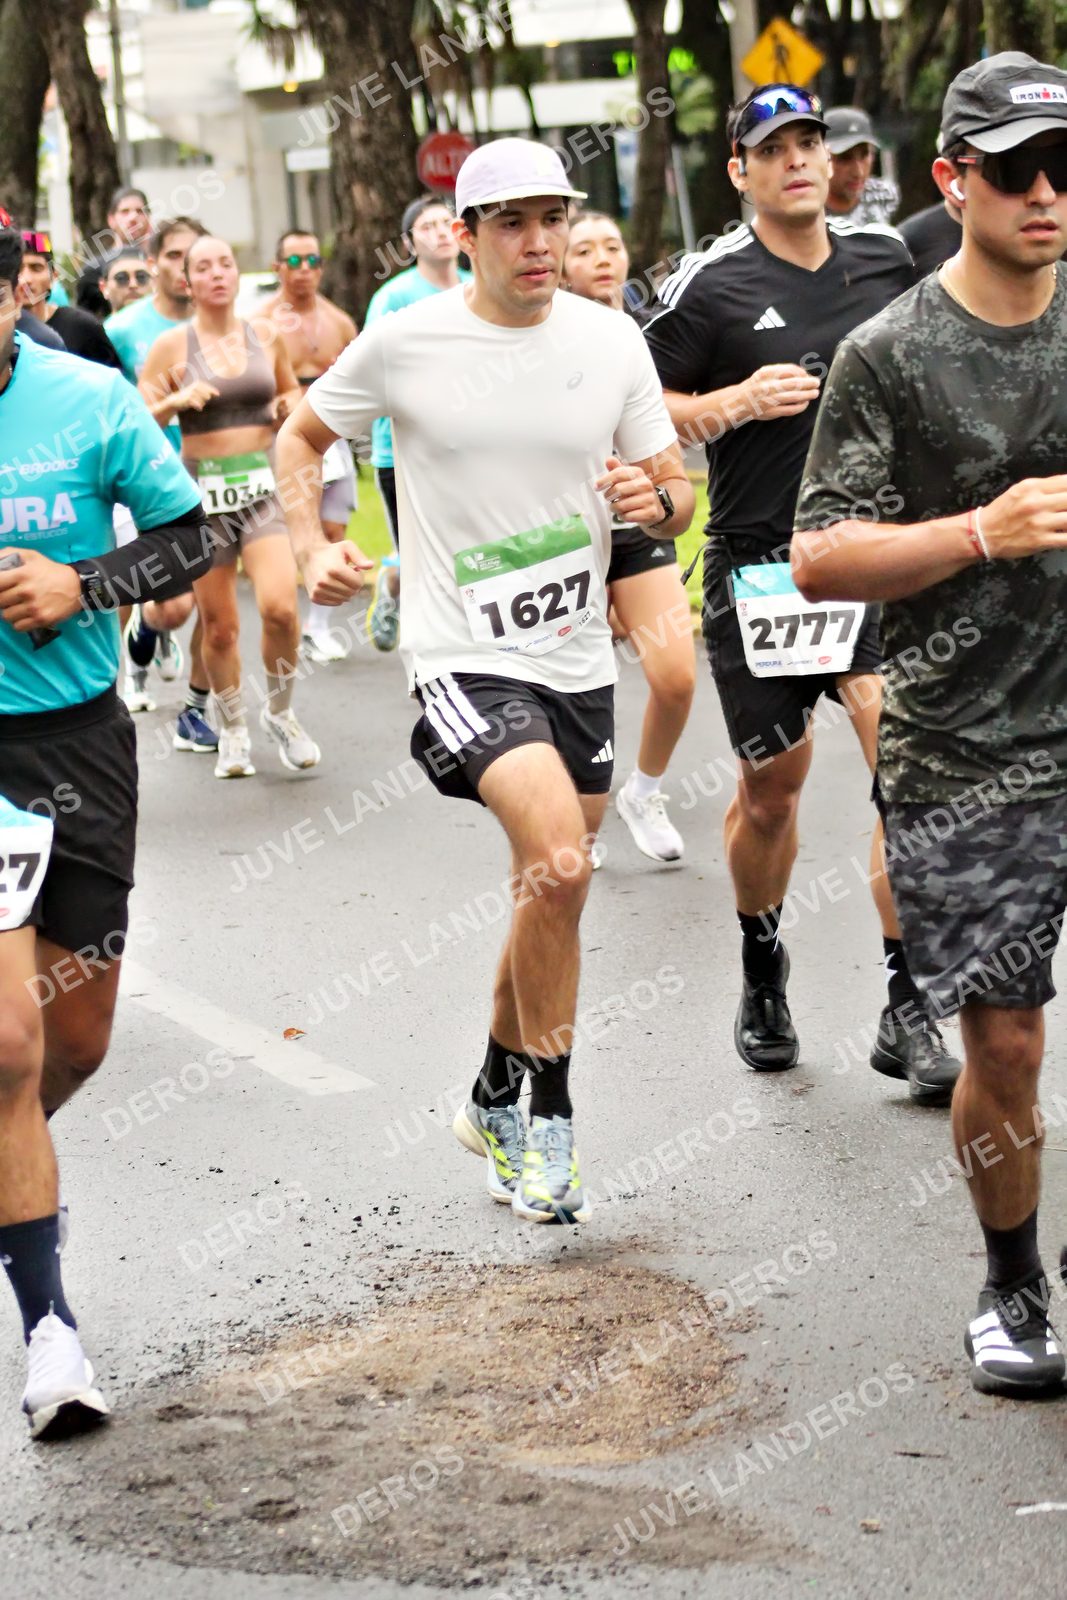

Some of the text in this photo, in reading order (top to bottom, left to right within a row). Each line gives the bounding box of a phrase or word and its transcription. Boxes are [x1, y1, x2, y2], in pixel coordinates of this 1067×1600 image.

[422, 149, 468, 176] ALT
[207, 482, 269, 509] 1034
[480, 570, 591, 639] 1627
[748, 610, 856, 651] 2777
